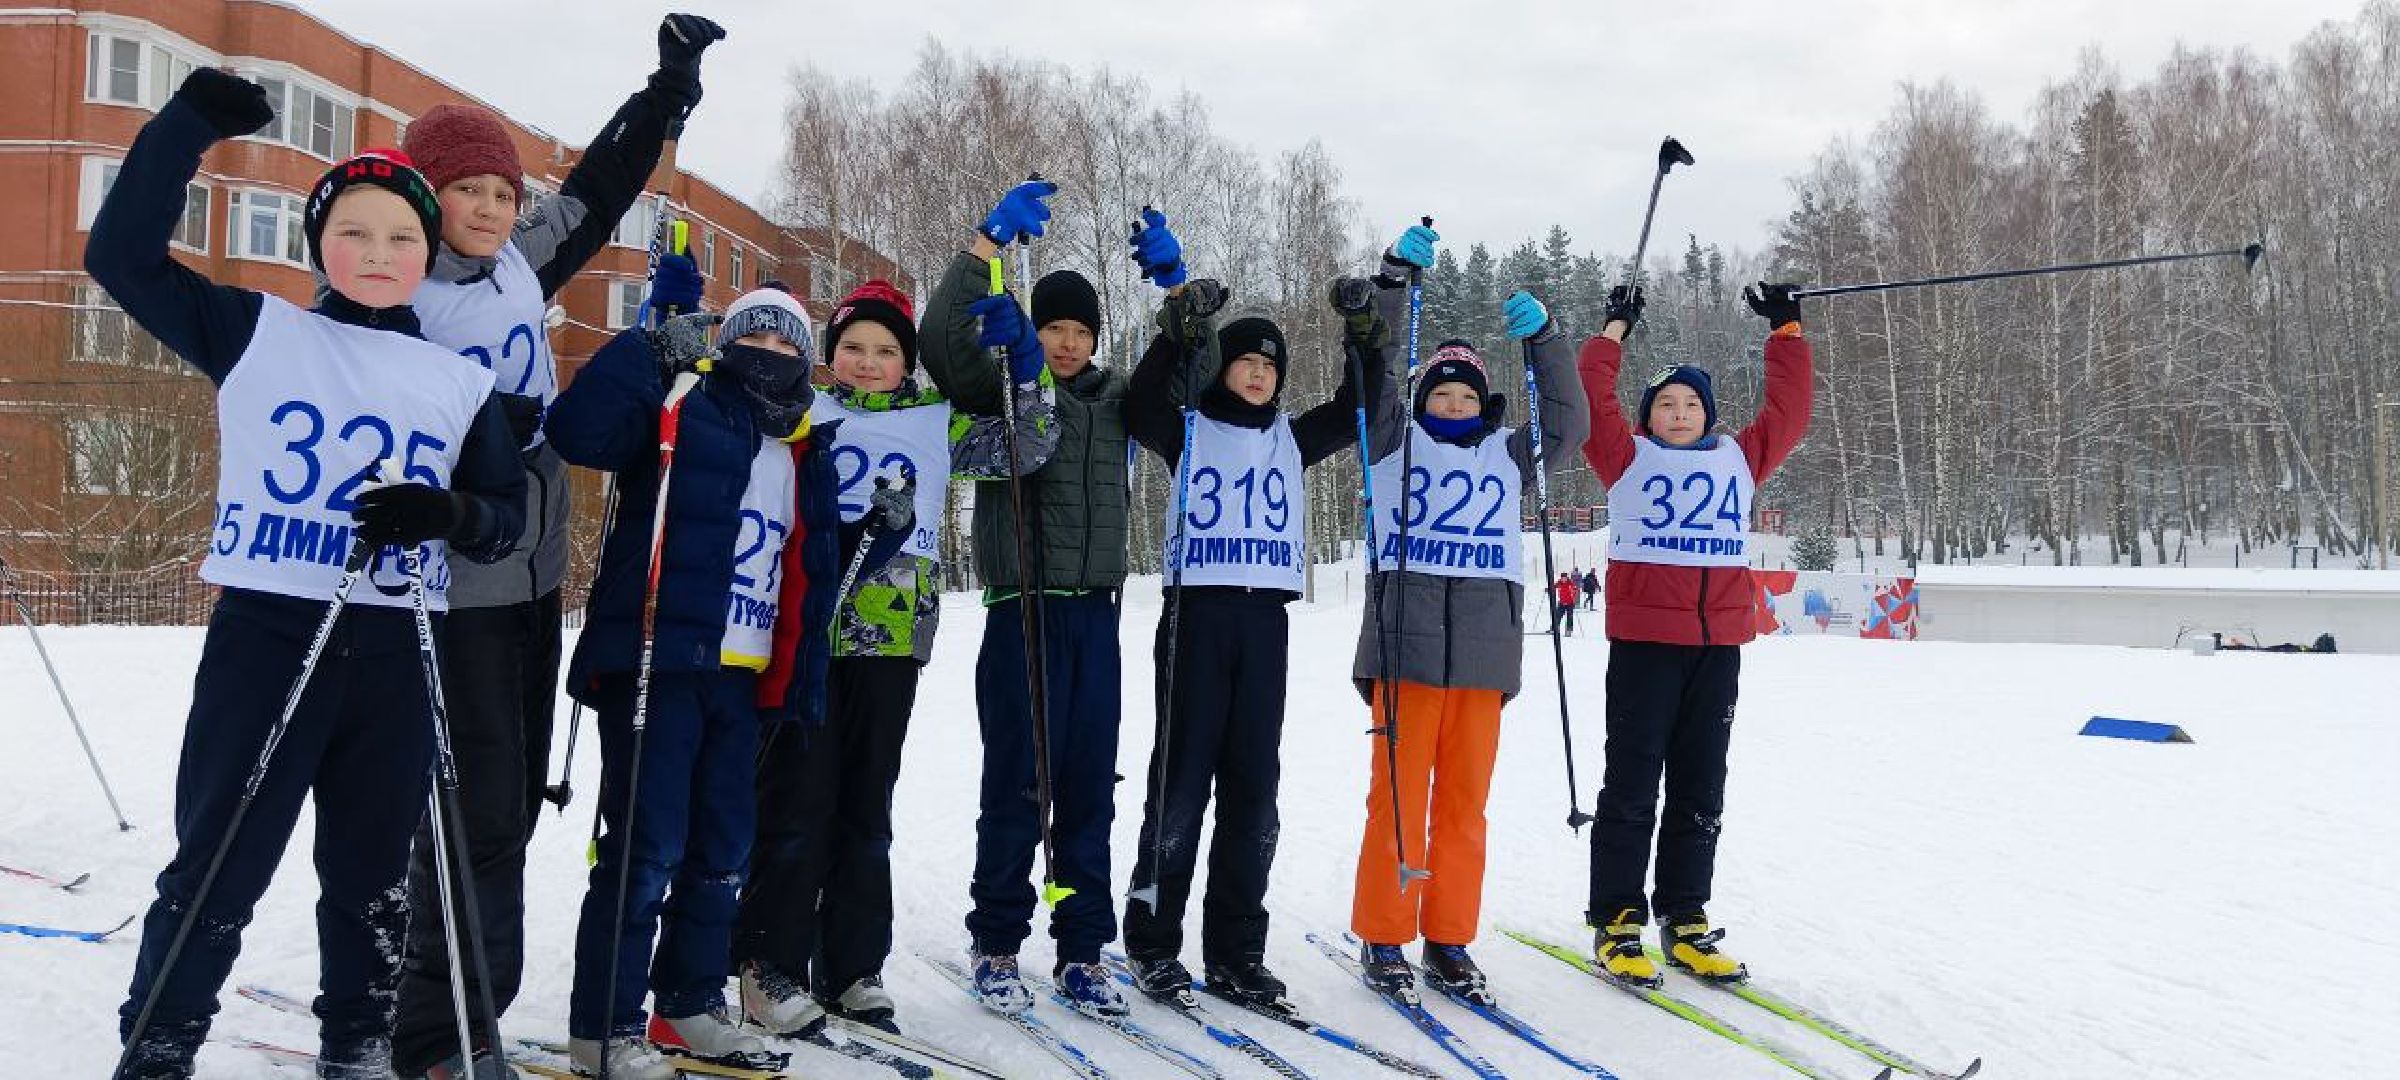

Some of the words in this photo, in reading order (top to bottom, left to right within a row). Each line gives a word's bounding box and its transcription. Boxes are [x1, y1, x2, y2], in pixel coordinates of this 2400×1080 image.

[263, 400, 447, 512] 325
[1187, 466, 1288, 532] 319
[1392, 466, 1506, 537] 322
[1641, 471, 1742, 532] 324
[1185, 537, 1291, 569] ДМИТРОВ
[1380, 532, 1506, 569] ДМИТРОВ
